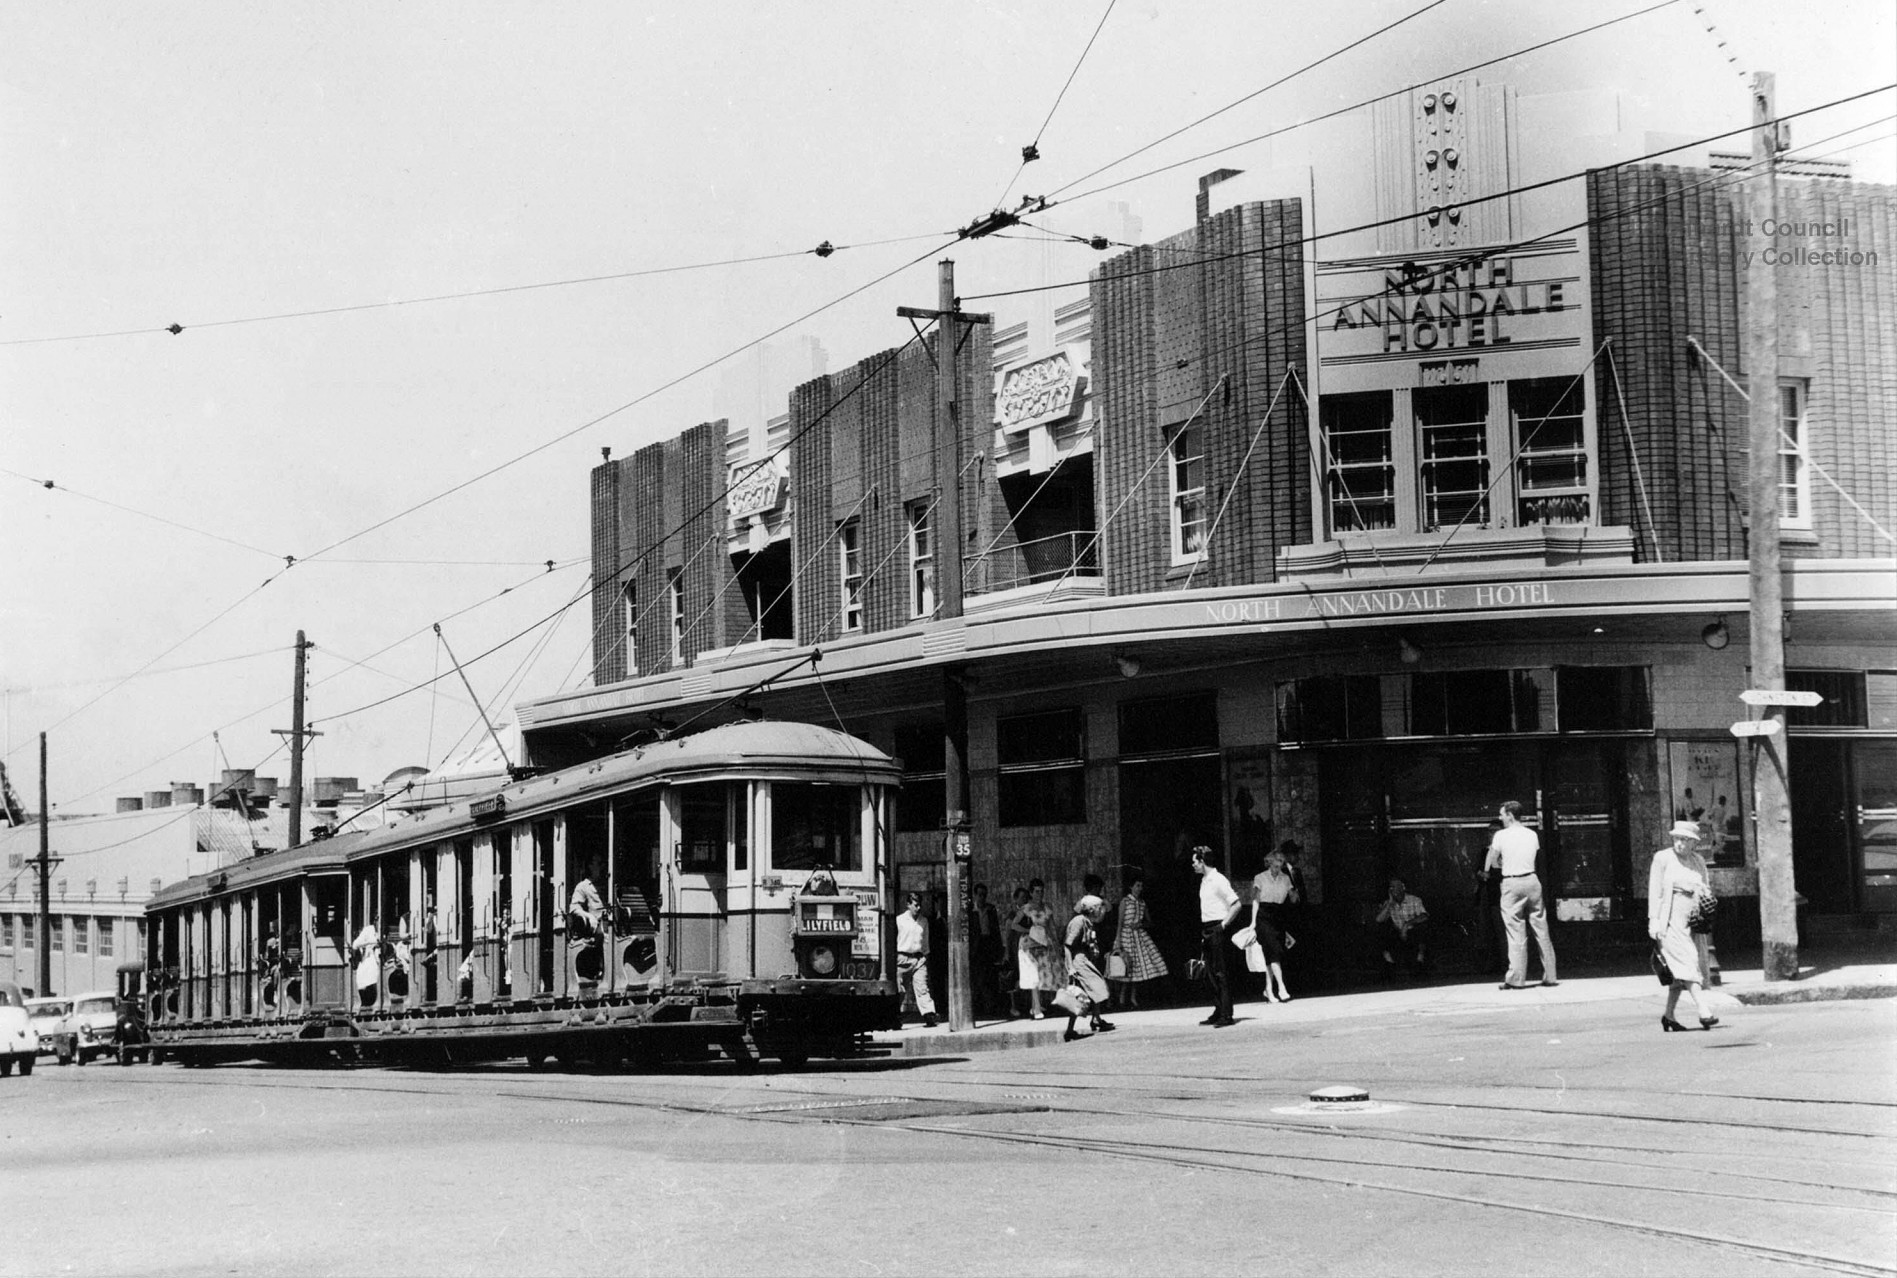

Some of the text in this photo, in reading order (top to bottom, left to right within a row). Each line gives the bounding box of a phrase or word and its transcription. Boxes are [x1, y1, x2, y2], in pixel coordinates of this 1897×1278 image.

[1384, 256, 1514, 298] NORTH
[1333, 282, 1565, 332] ANNANDALE
[1383, 314, 1512, 352] HOTEL
[1206, 583, 1555, 623] NORTH ANNANDALE HOTEL
[956, 843, 971, 856] 35
[801, 919, 851, 932] LILYFIELD
[840, 962, 876, 979] 1037
